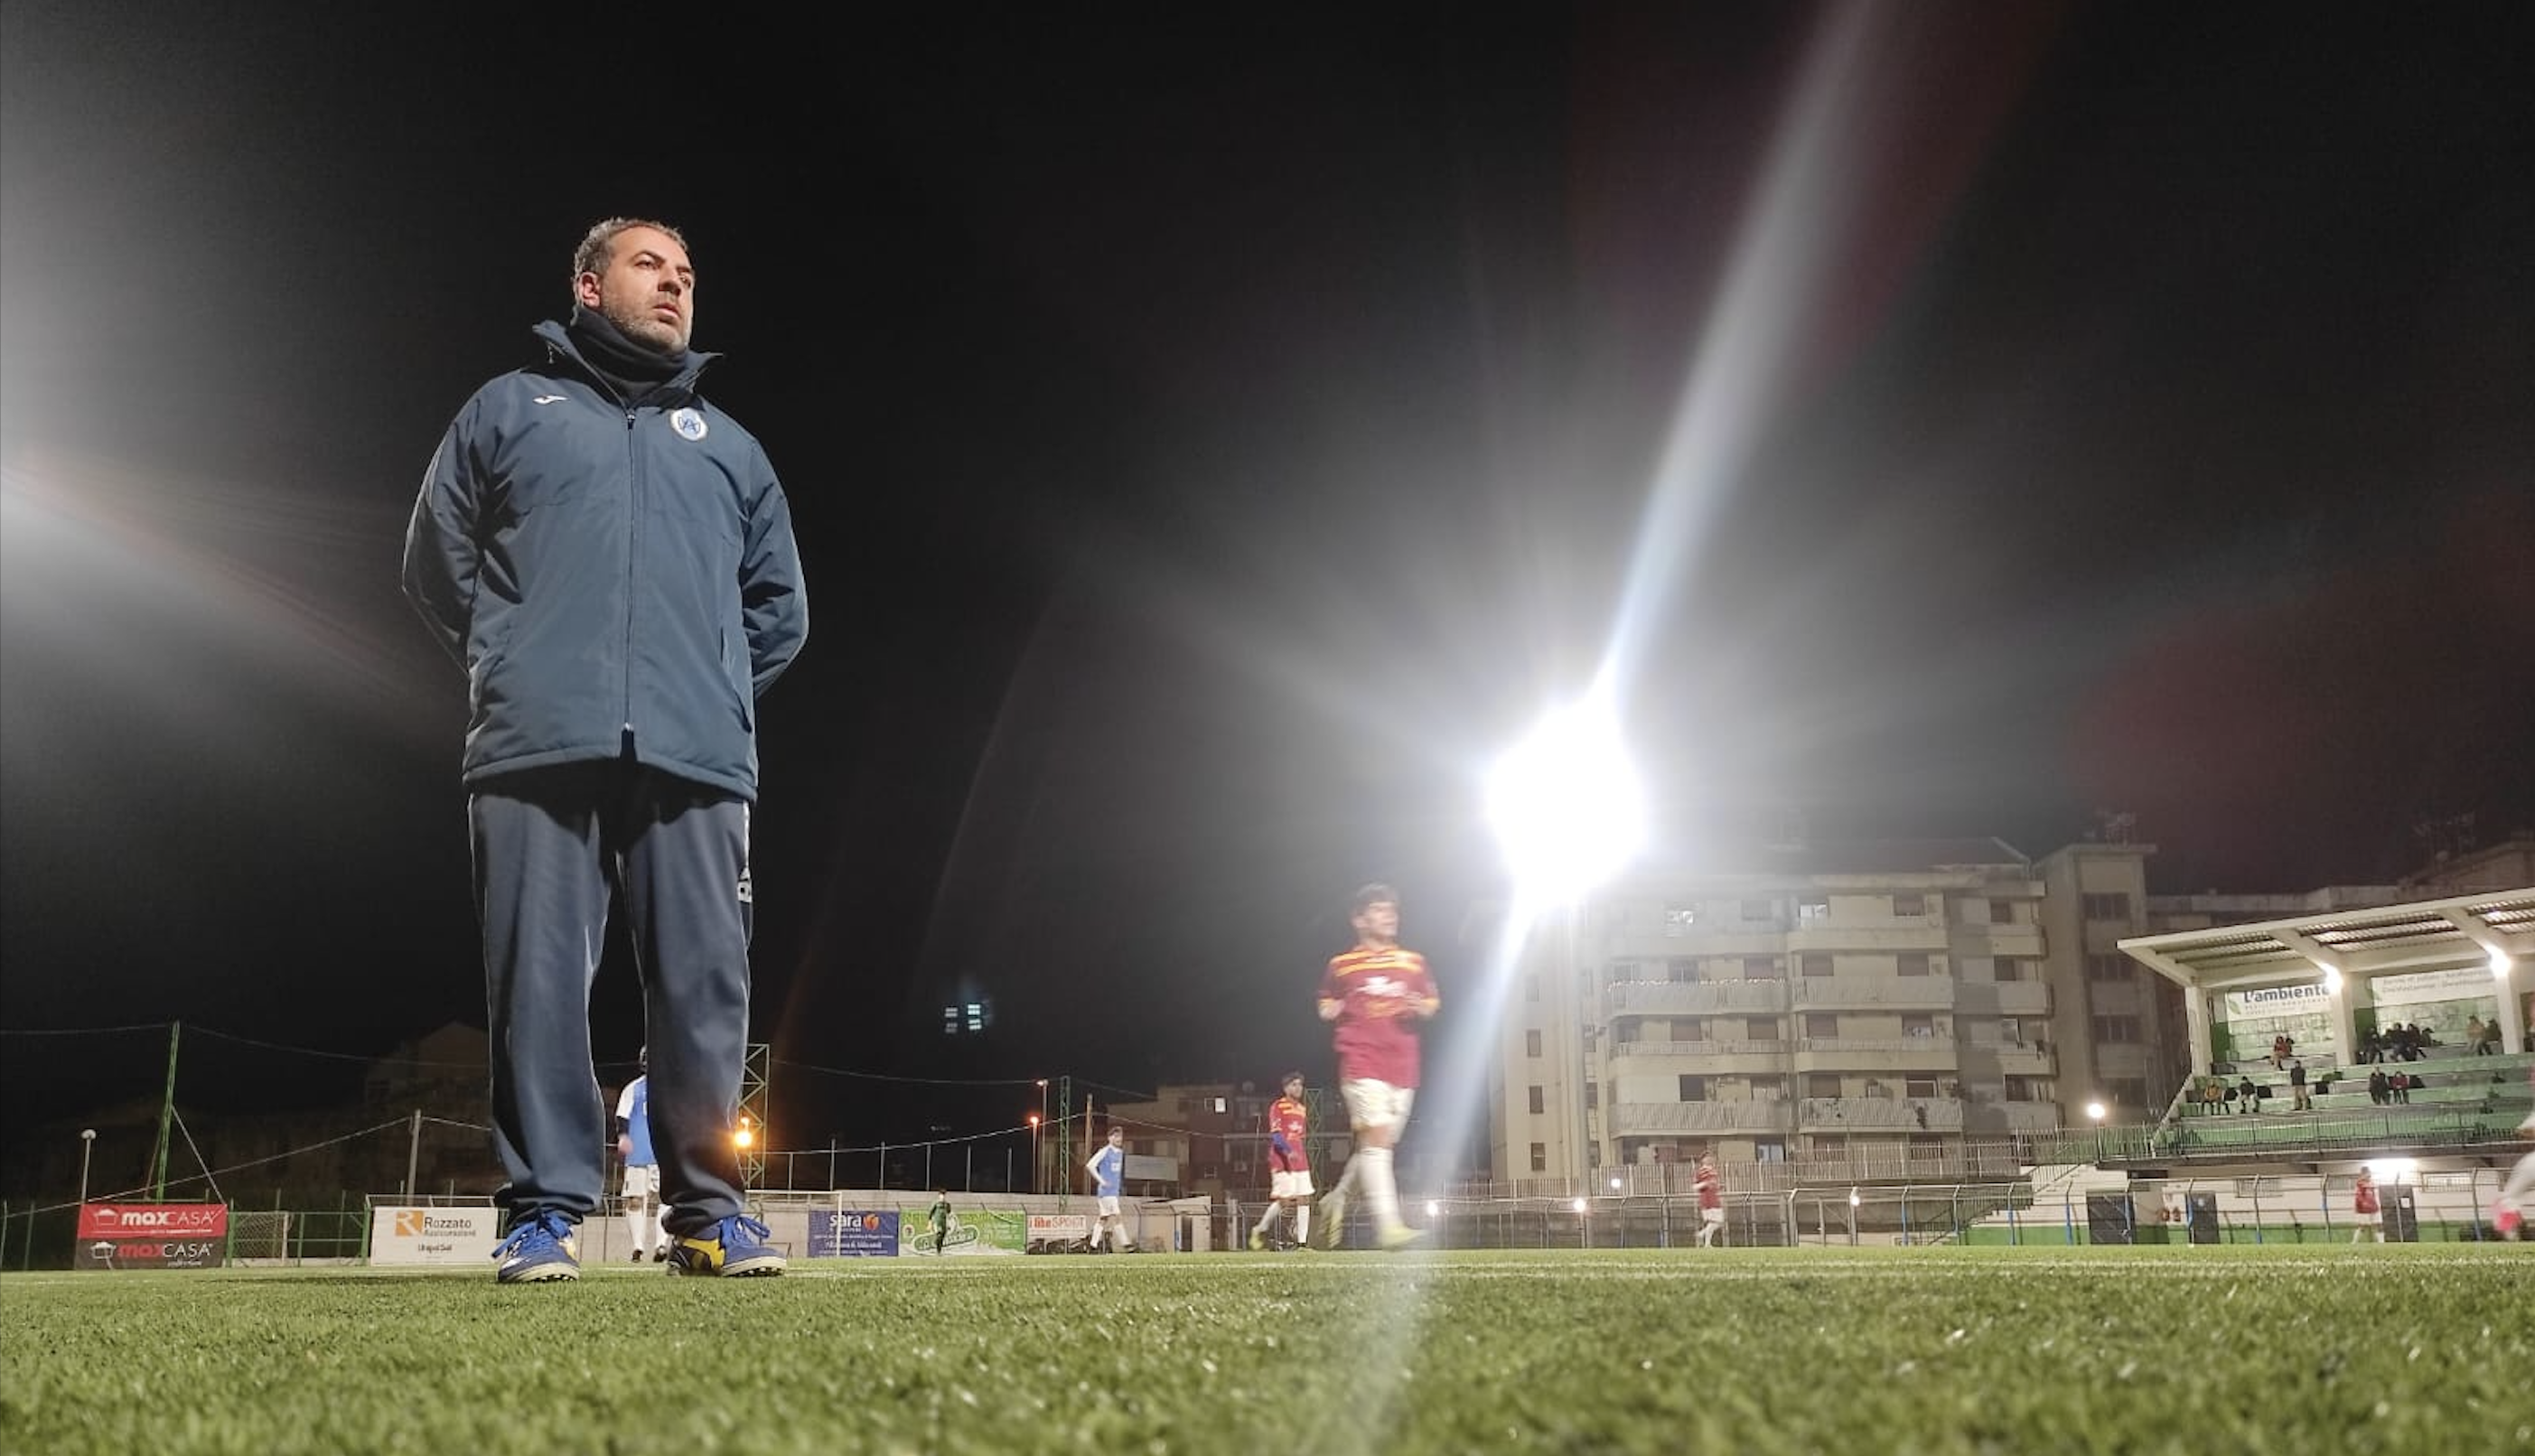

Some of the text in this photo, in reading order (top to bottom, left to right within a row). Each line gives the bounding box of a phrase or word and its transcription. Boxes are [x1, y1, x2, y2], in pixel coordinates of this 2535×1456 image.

[121, 1211, 214, 1226] maxCASA
[425, 1217, 472, 1228] Rozzato
[829, 1214, 862, 1227] sara
[117, 1242, 211, 1257] maxCASA
